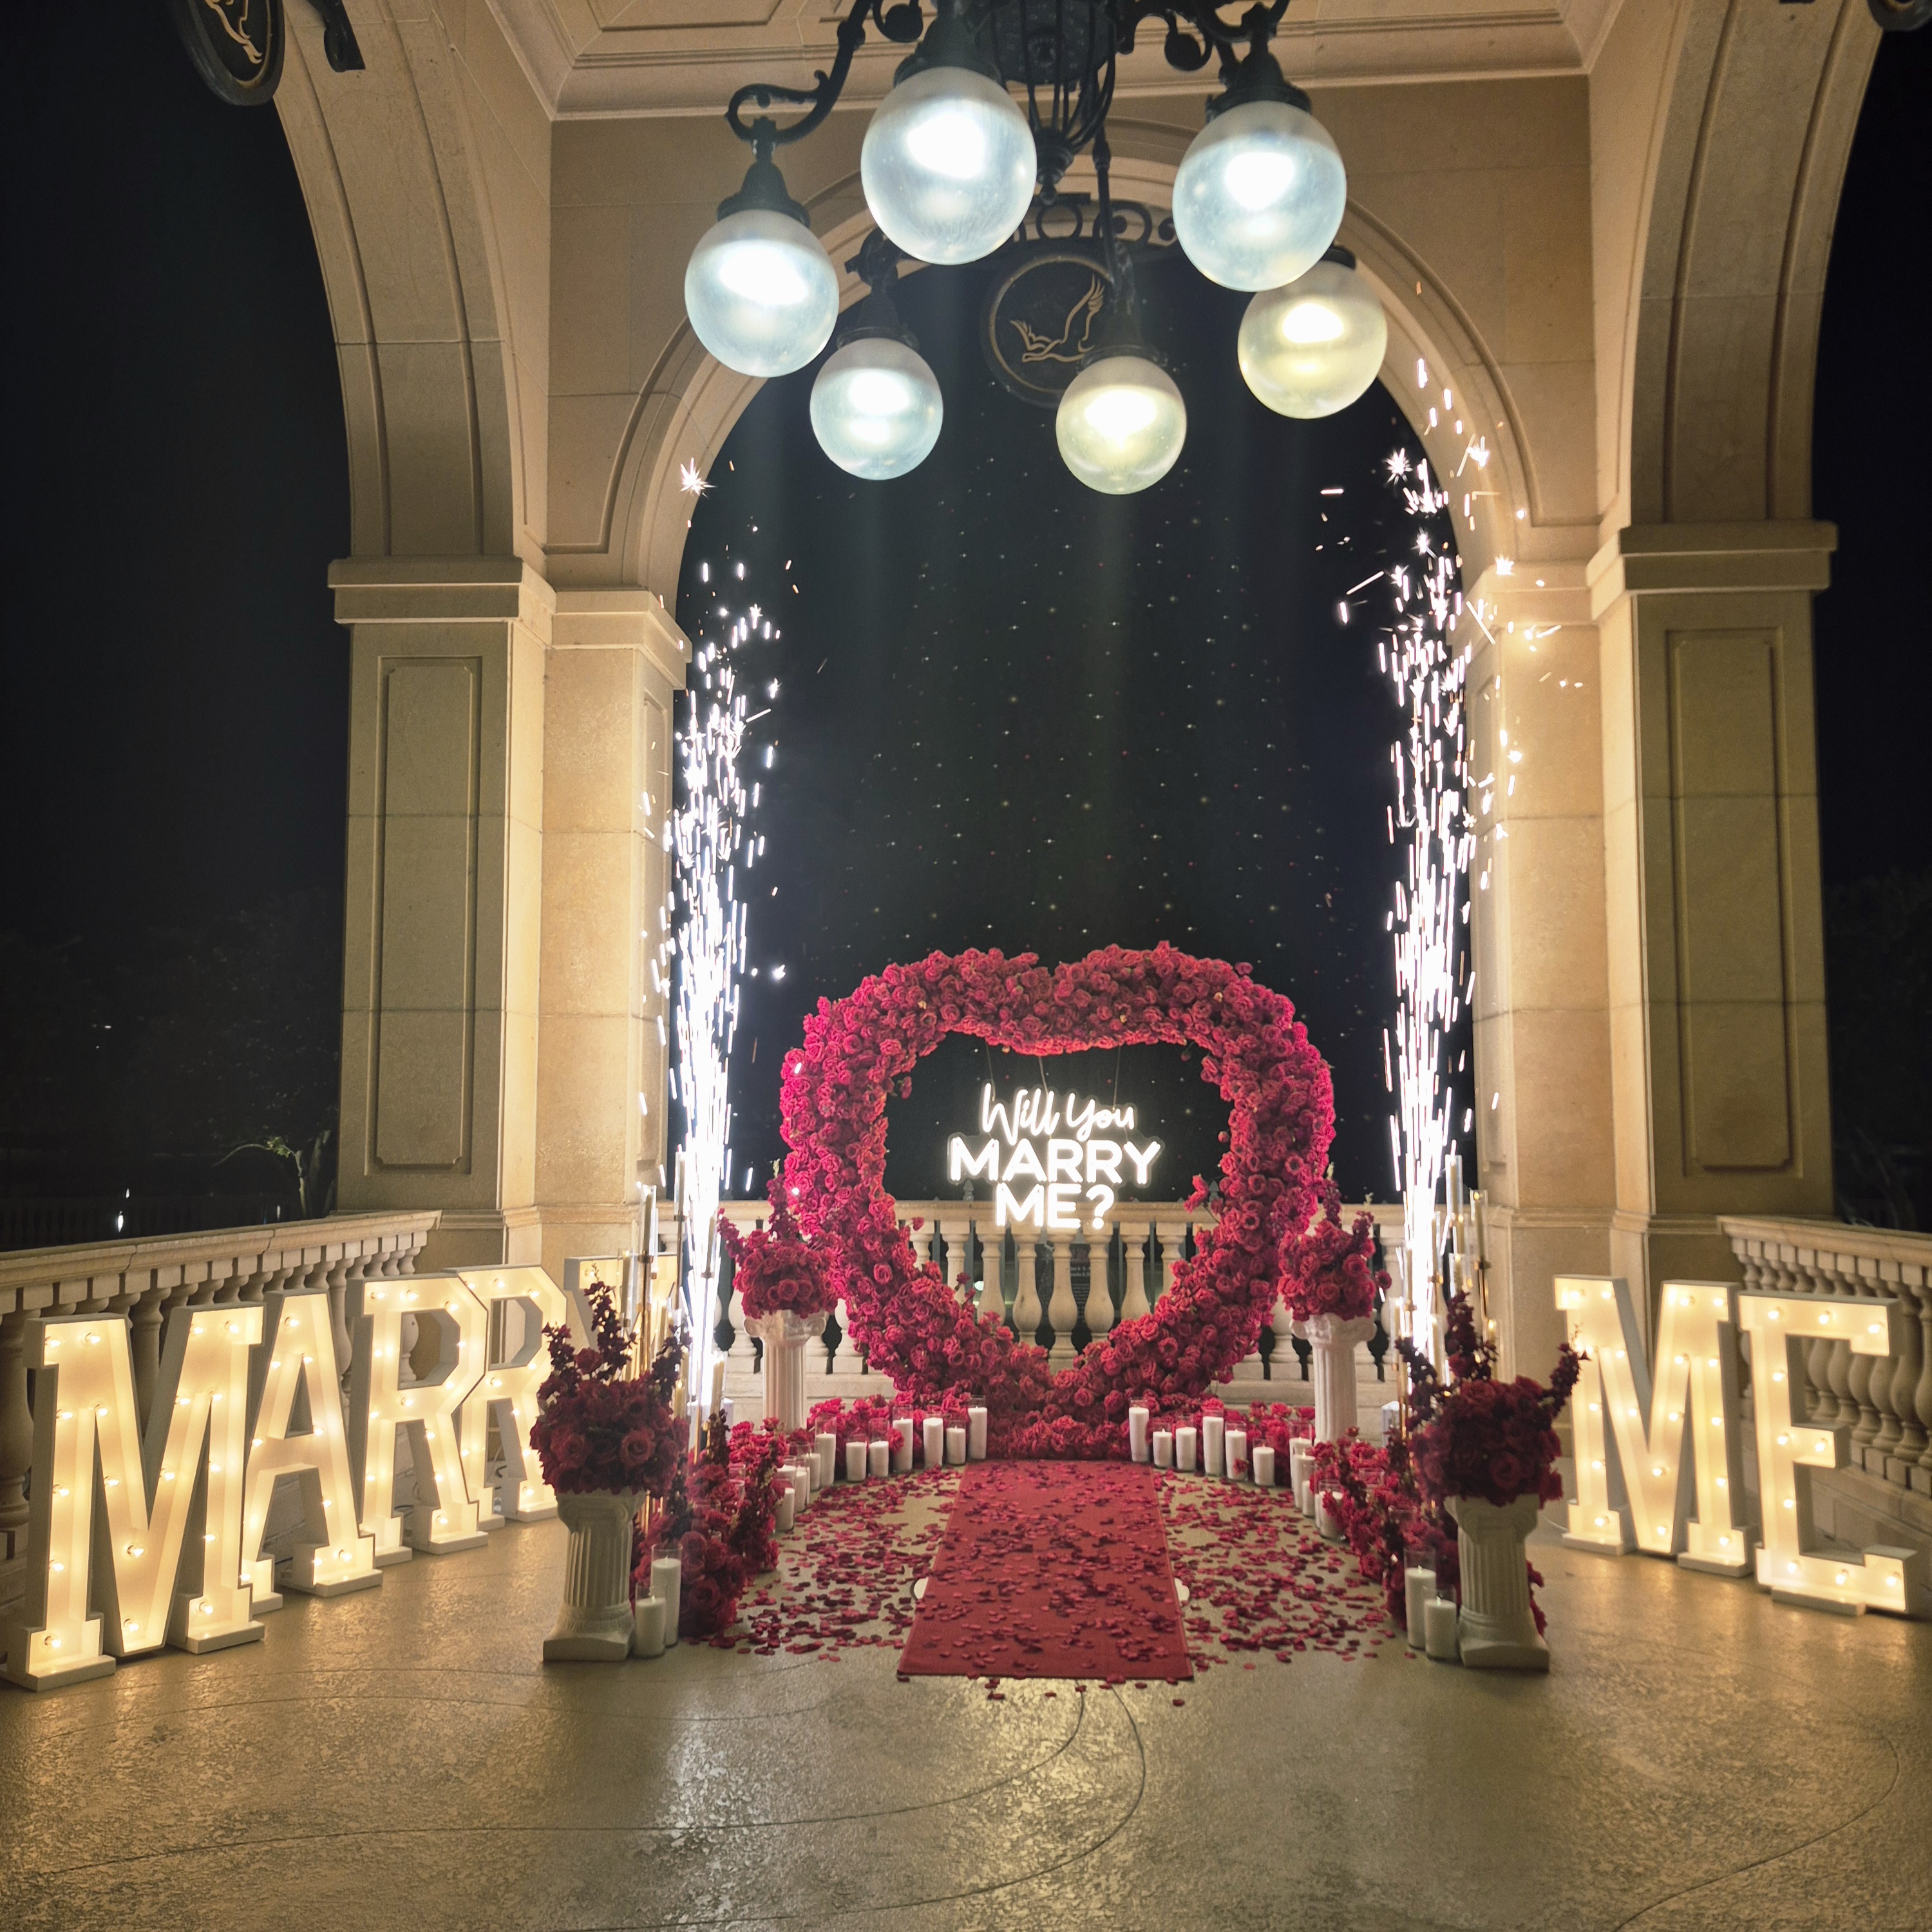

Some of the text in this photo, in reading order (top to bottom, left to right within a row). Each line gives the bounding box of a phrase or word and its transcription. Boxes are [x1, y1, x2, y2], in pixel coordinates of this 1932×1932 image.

[981, 1082, 1135, 1146] Will You
[950, 1135, 1161, 1185] MARRY
[995, 1182, 1115, 1230] ME?
[1554, 1274, 1910, 1613] ME
